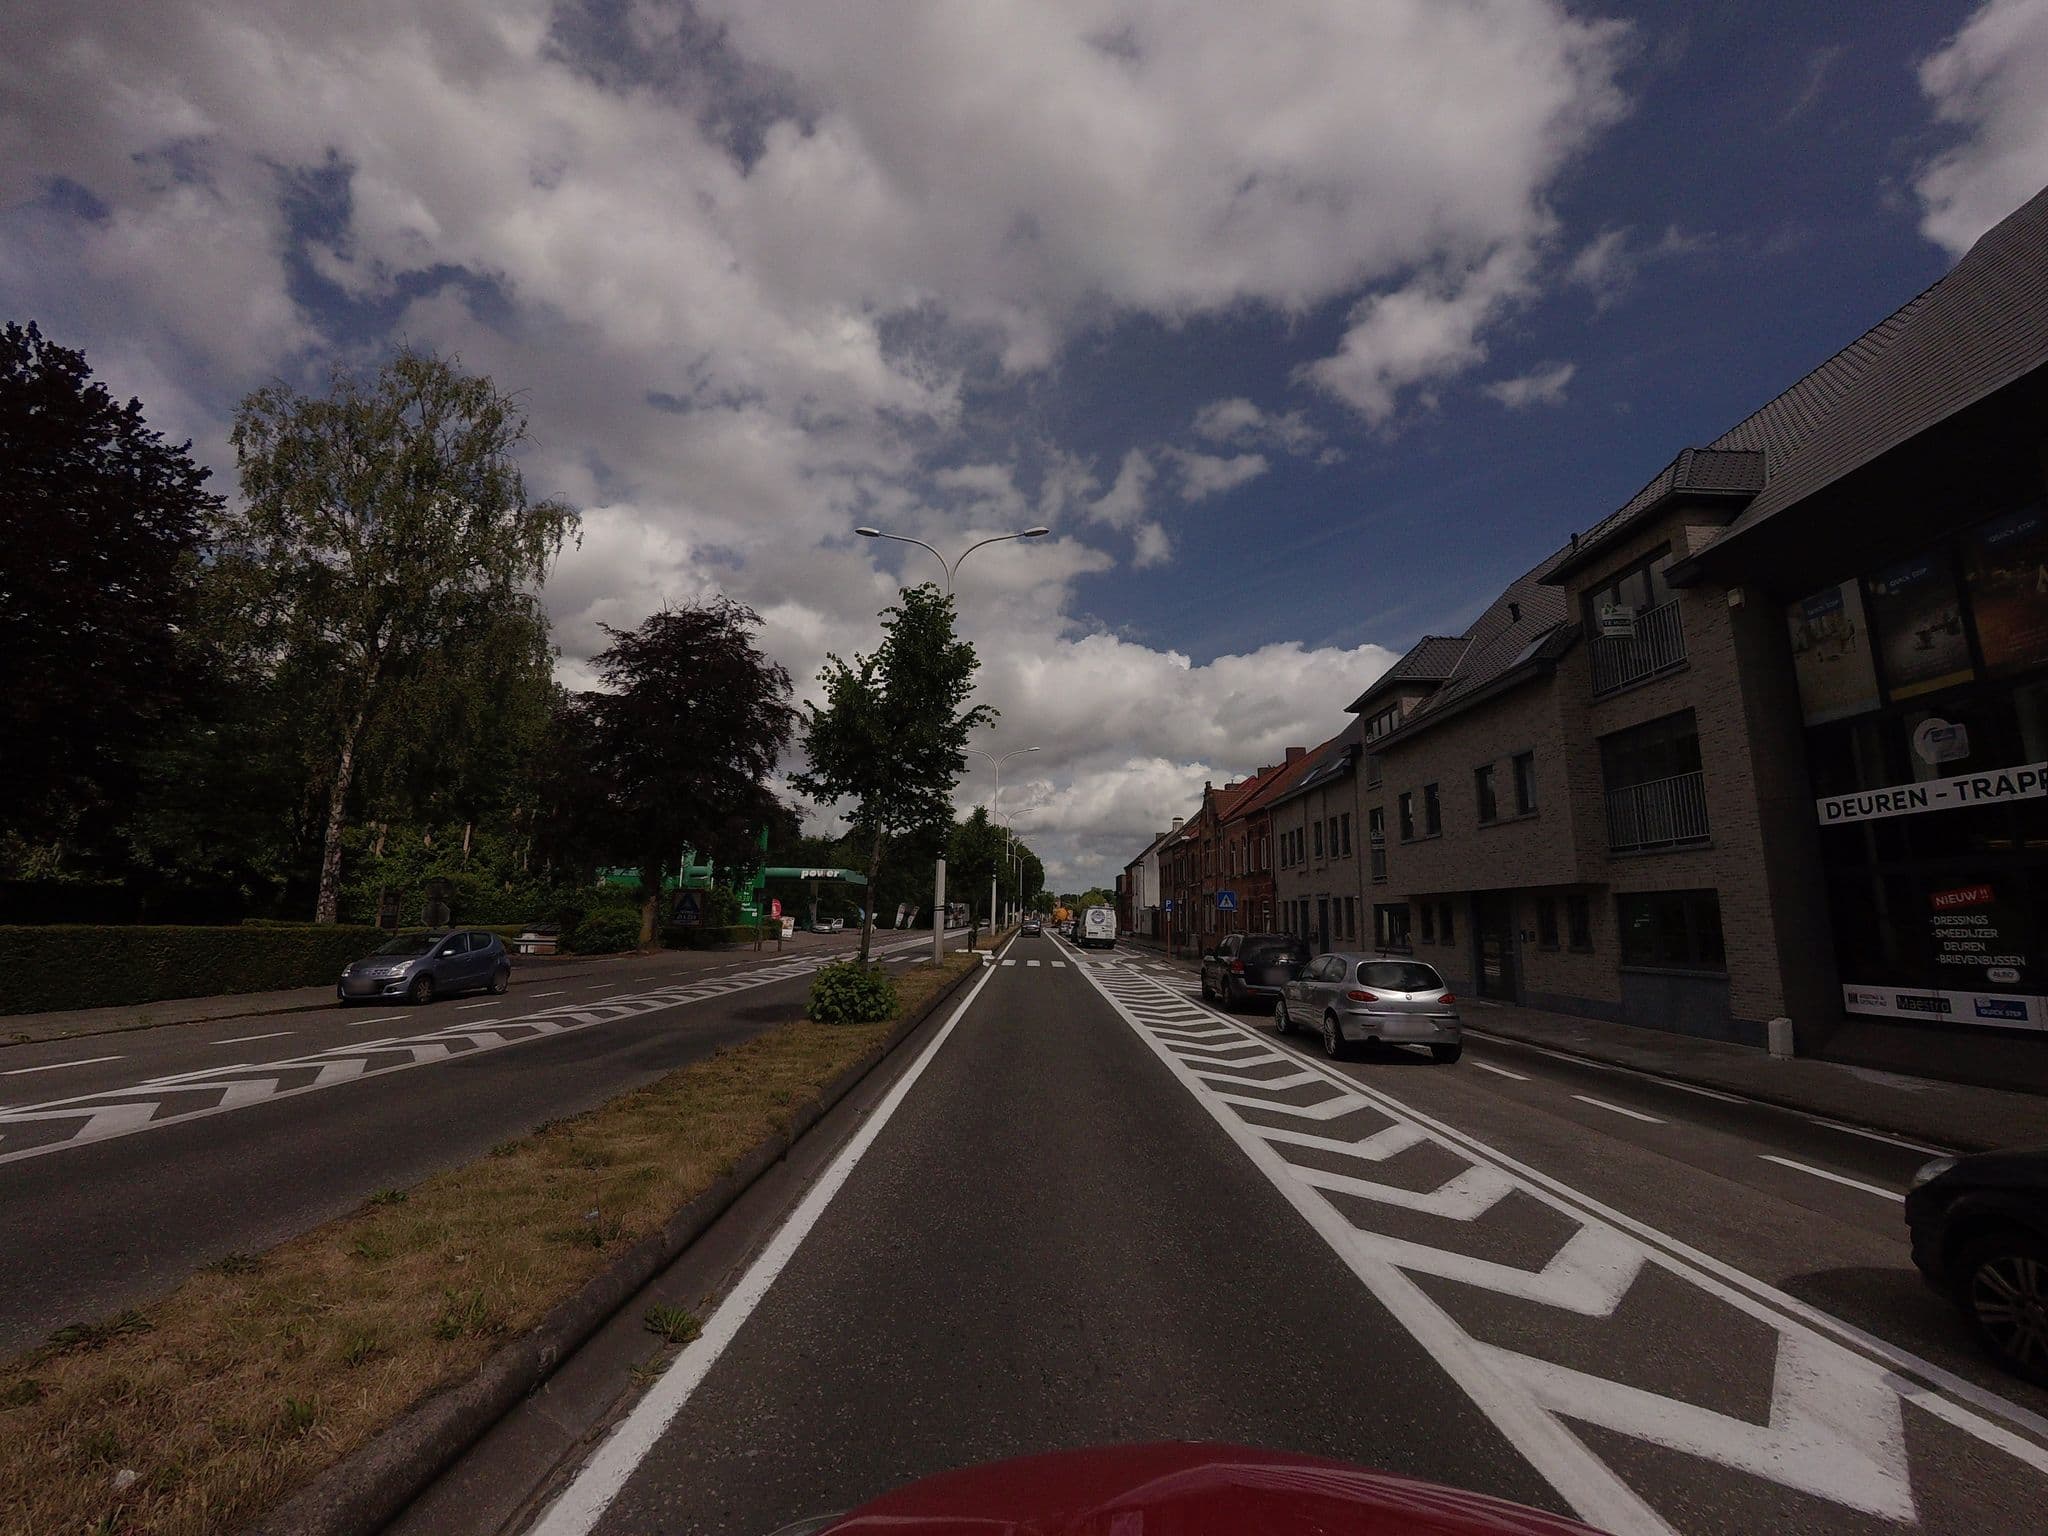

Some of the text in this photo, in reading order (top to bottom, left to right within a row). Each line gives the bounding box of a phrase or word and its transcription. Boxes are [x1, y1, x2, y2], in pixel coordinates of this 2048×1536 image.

[1825, 787, 1929, 820] DEUREN
[1935, 889, 1977, 907] NIEUW
[1943, 941, 1987, 952] DEUREN
[1897, 994, 1950, 1013] Maestro
